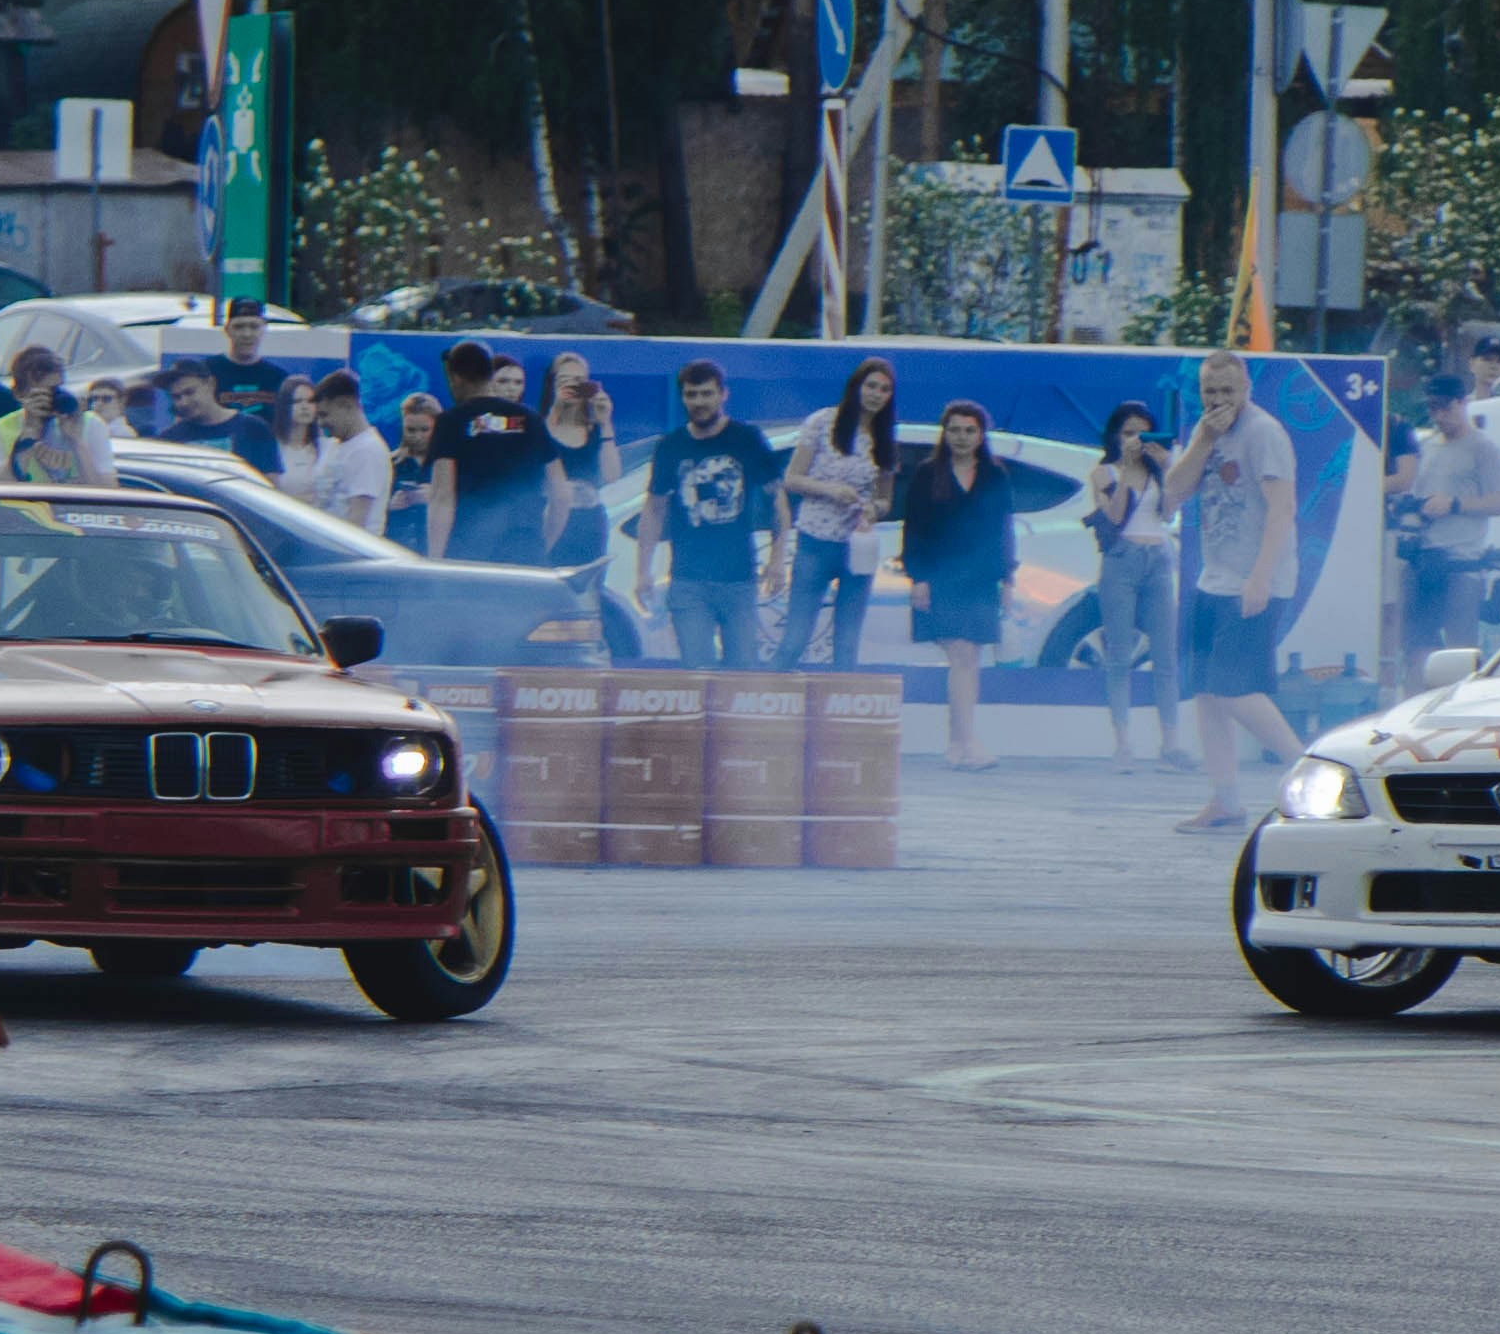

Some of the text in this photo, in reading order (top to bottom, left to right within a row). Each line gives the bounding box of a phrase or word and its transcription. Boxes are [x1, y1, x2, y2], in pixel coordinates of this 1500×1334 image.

[1344, 372, 1378, 401] 3+
[65, 512, 220, 540] DRIFT GAMES
